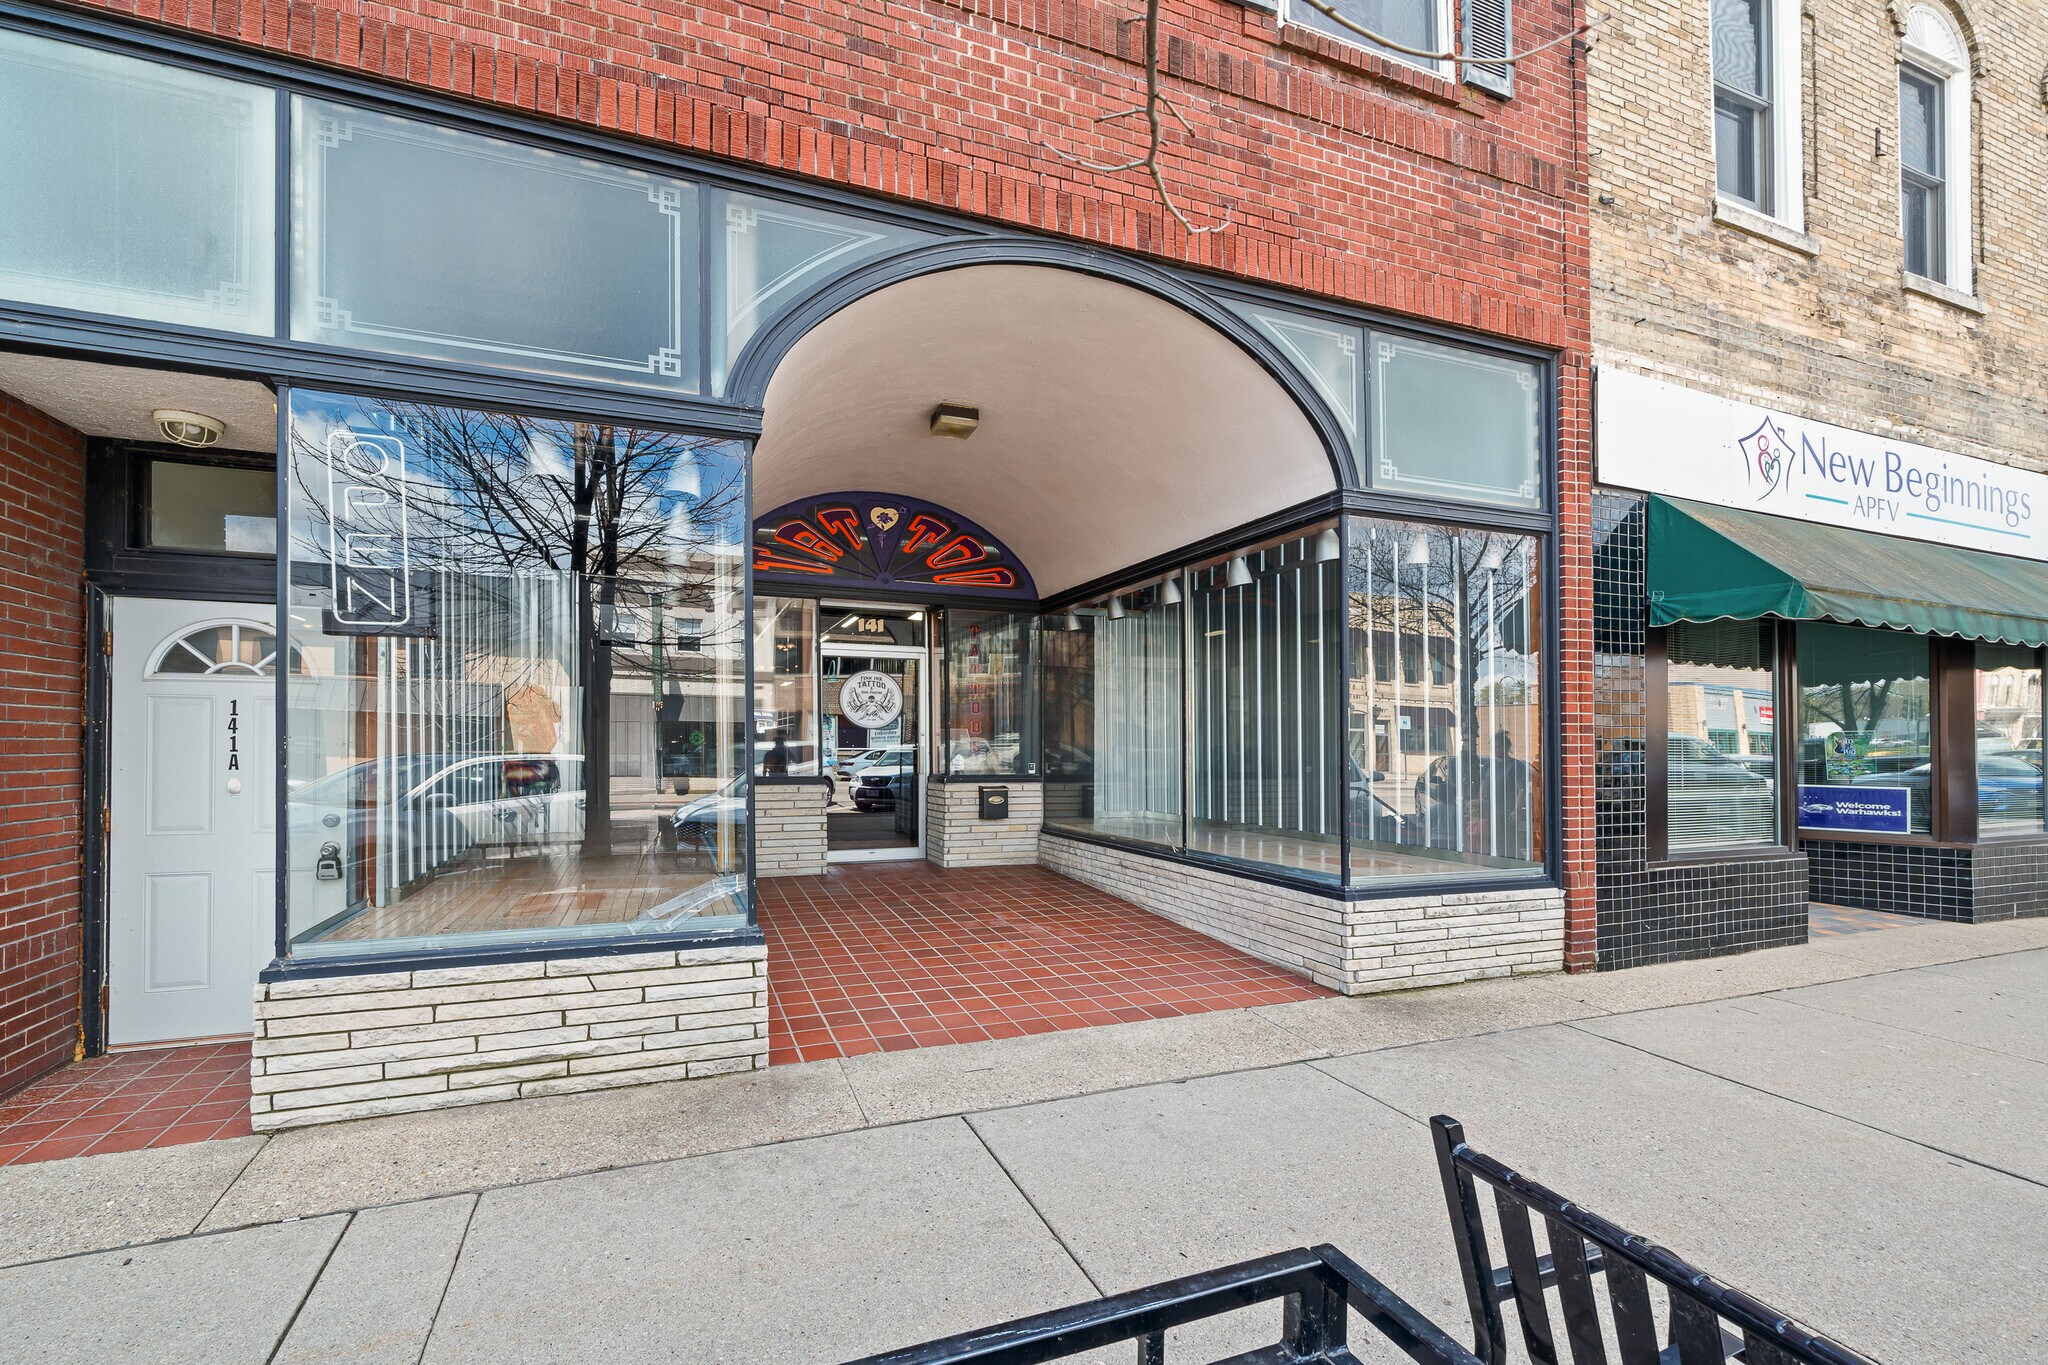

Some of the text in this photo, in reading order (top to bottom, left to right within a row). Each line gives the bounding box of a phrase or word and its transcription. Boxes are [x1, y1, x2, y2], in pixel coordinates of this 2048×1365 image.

[1801, 431, 2031, 528] New Beginnings
[1852, 494, 1900, 522] APFV
[343, 441, 395, 616] OPEN
[857, 618, 885, 633] 141
[857, 680, 886, 690] TATTOO
[227, 699, 239, 771] 141A
[1835, 801, 1891, 810] Welcome
[1836, 807, 1902, 817] Warhawks!
